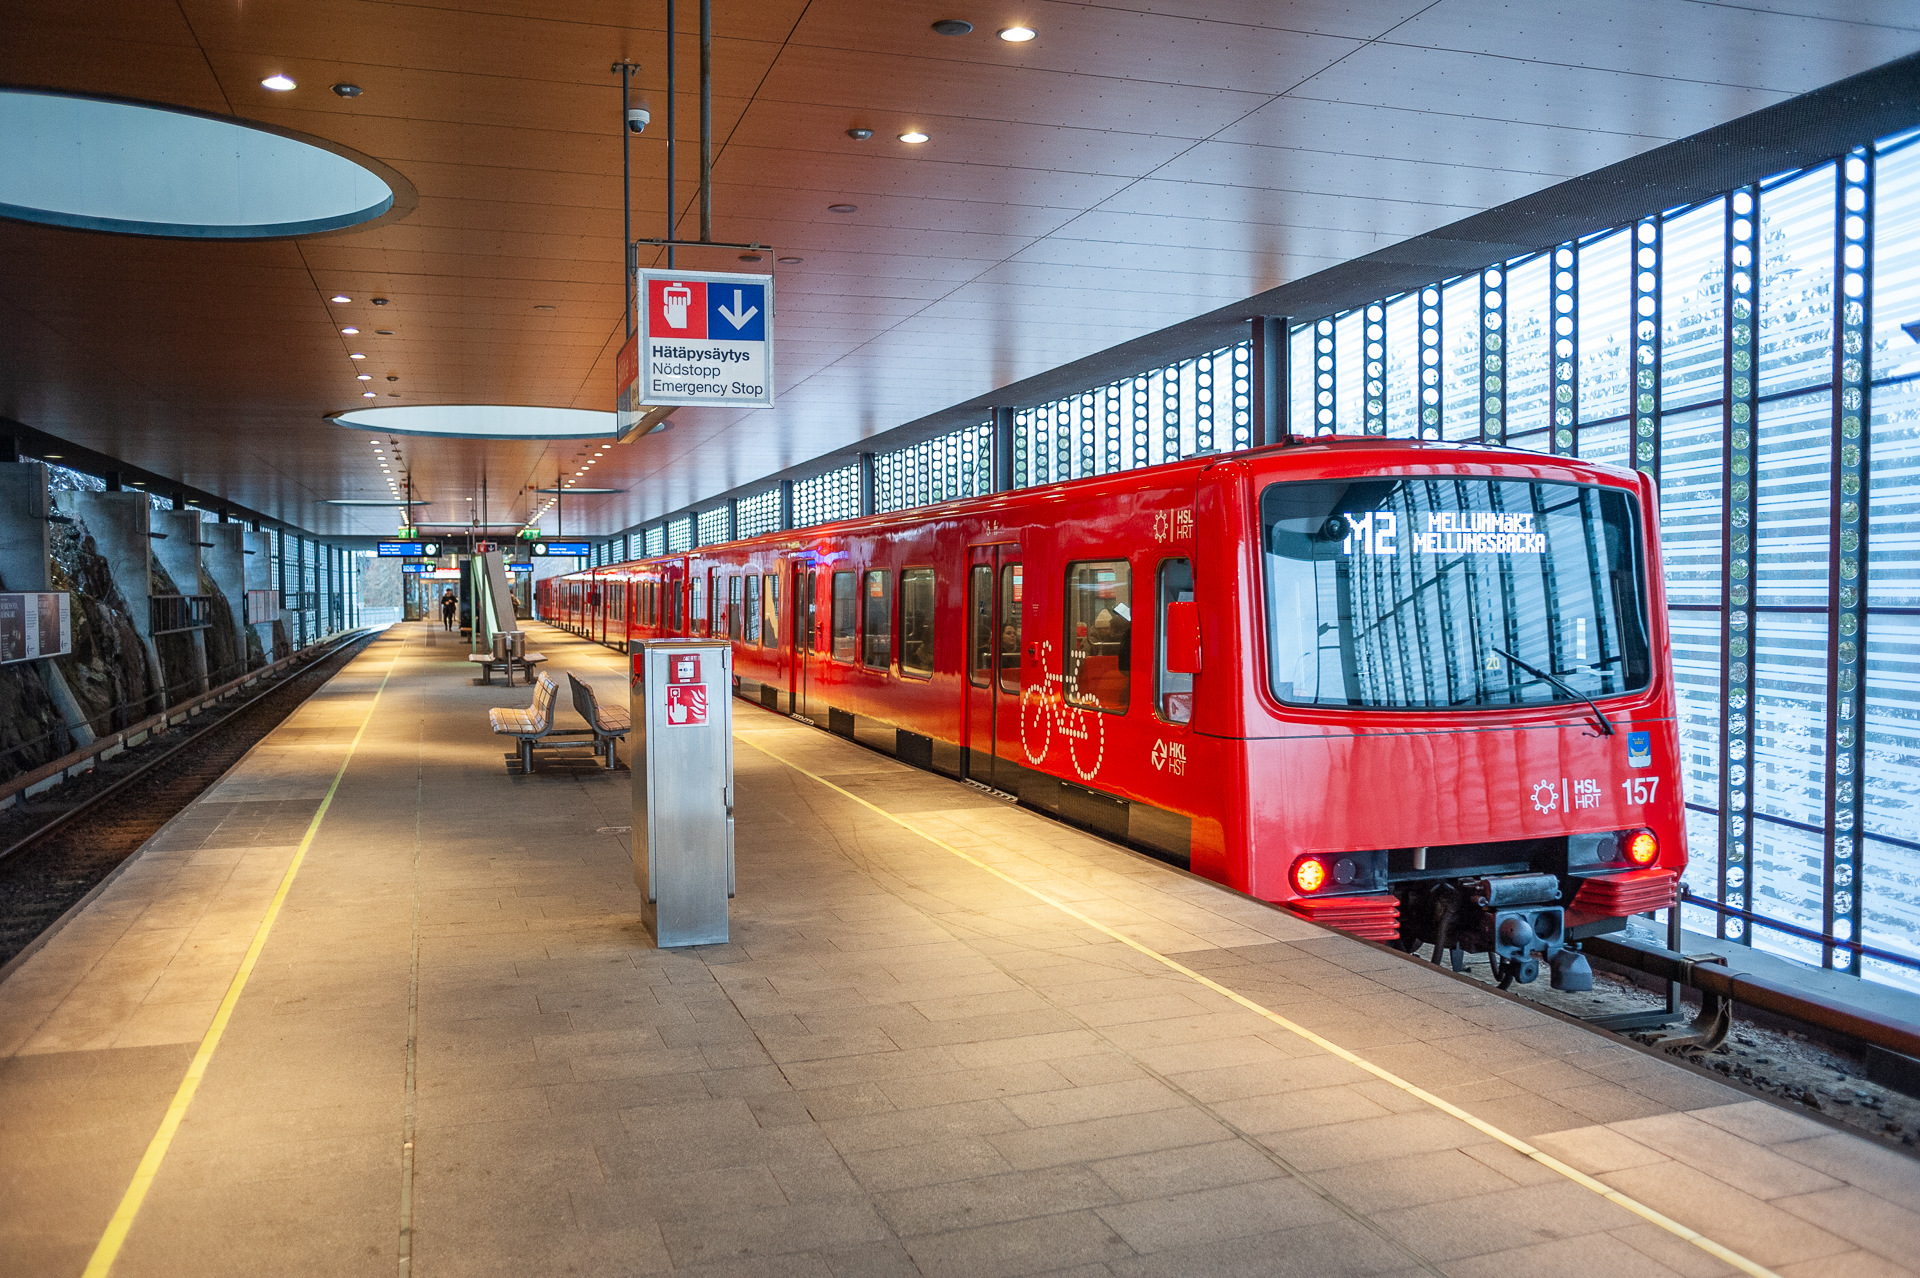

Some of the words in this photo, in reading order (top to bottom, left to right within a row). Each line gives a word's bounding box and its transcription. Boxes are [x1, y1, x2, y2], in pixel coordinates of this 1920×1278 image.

[652, 345, 750, 363] Hätäpysäytys
[652, 363, 721, 379] Nödstopp
[653, 379, 728, 397] Emergency
[731, 381, 763, 397] Stop
[1176, 509, 1194, 524] HSL
[1176, 524, 1194, 540] HRT
[1343, 511, 1398, 555] M2
[1413, 532, 1546, 554] MELLUNGSBACKA
[1485, 657, 1500, 670] 20
[1169, 741, 1187, 760] HKL
[1168, 757, 1187, 777] HST
[1573, 778, 1602, 795] HSL
[1621, 776, 1660, 806] 157
[1574, 793, 1602, 810] HRT
